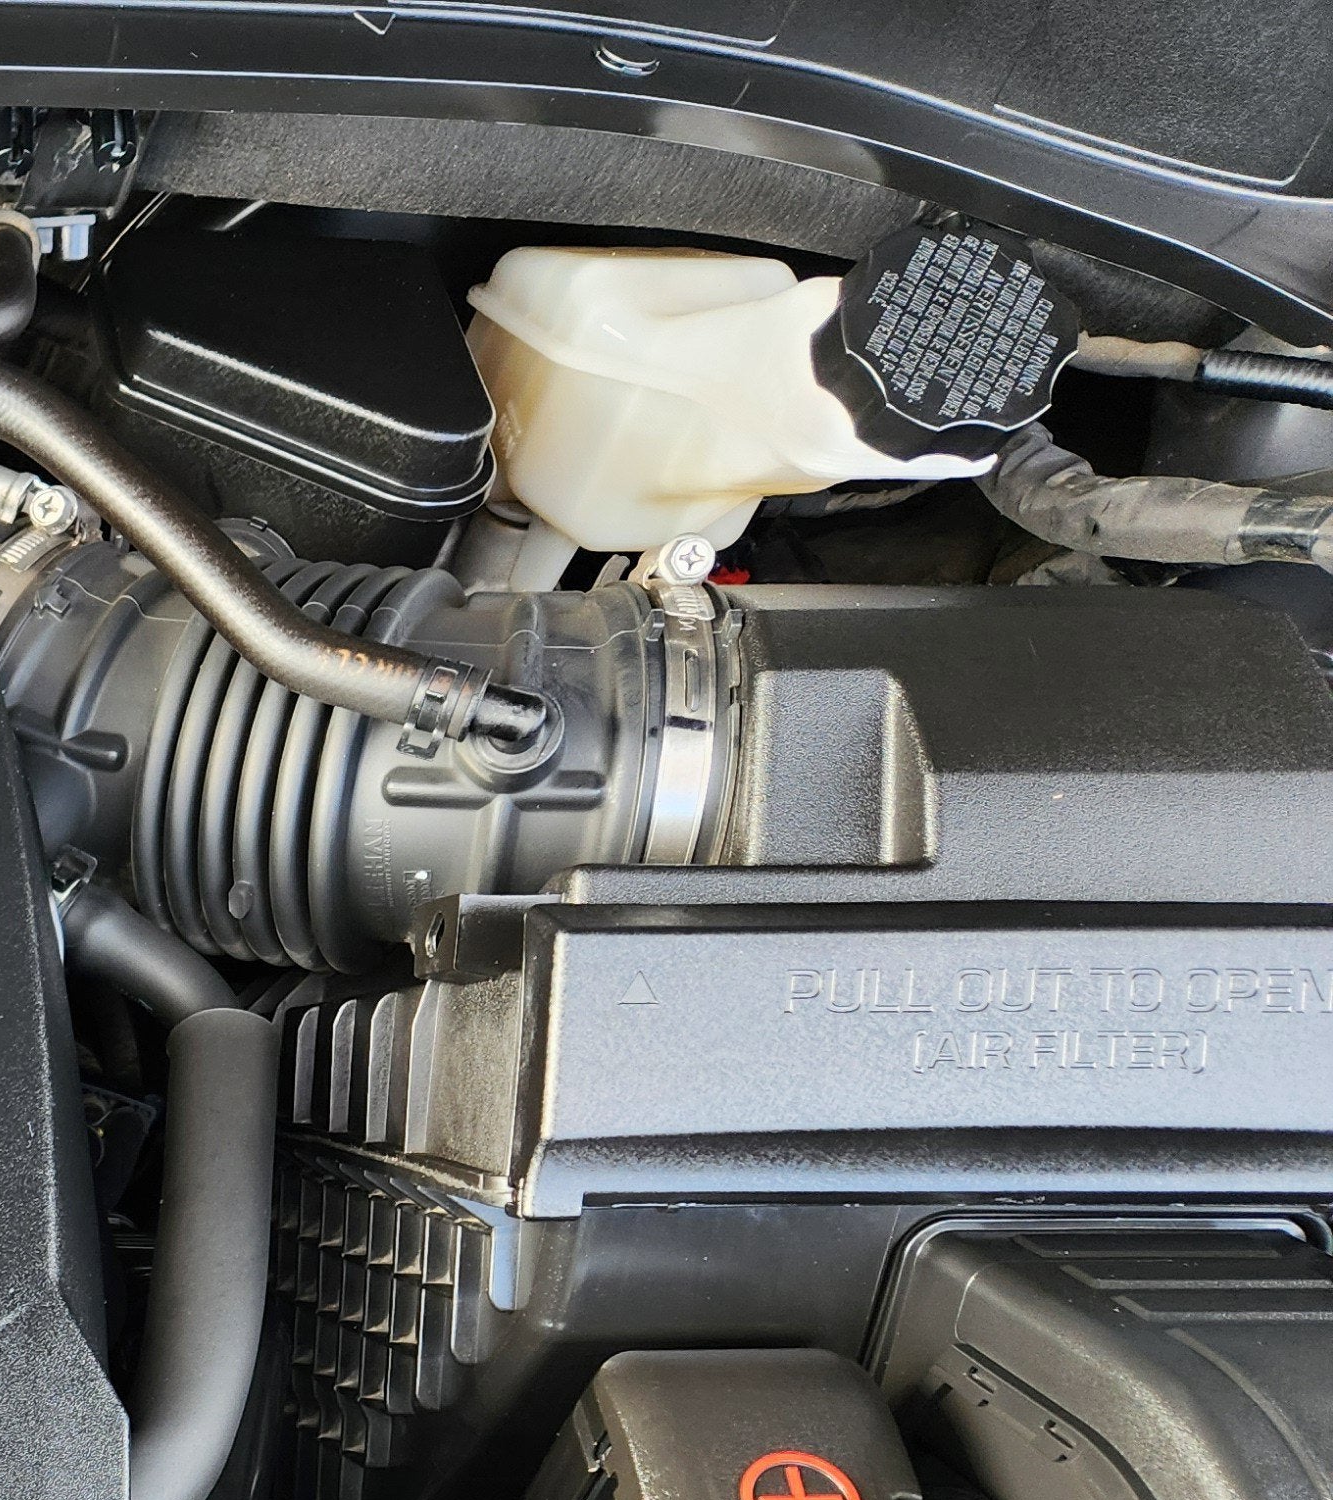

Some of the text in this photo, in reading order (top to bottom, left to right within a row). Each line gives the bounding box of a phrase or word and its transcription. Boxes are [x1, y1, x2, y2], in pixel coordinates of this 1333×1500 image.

[932, 268, 1005, 389] AVERTISSEMENT
[1014, 332, 1058, 396] WARNING
[784, 967, 1333, 1014] PULL OUT TO OPEN
